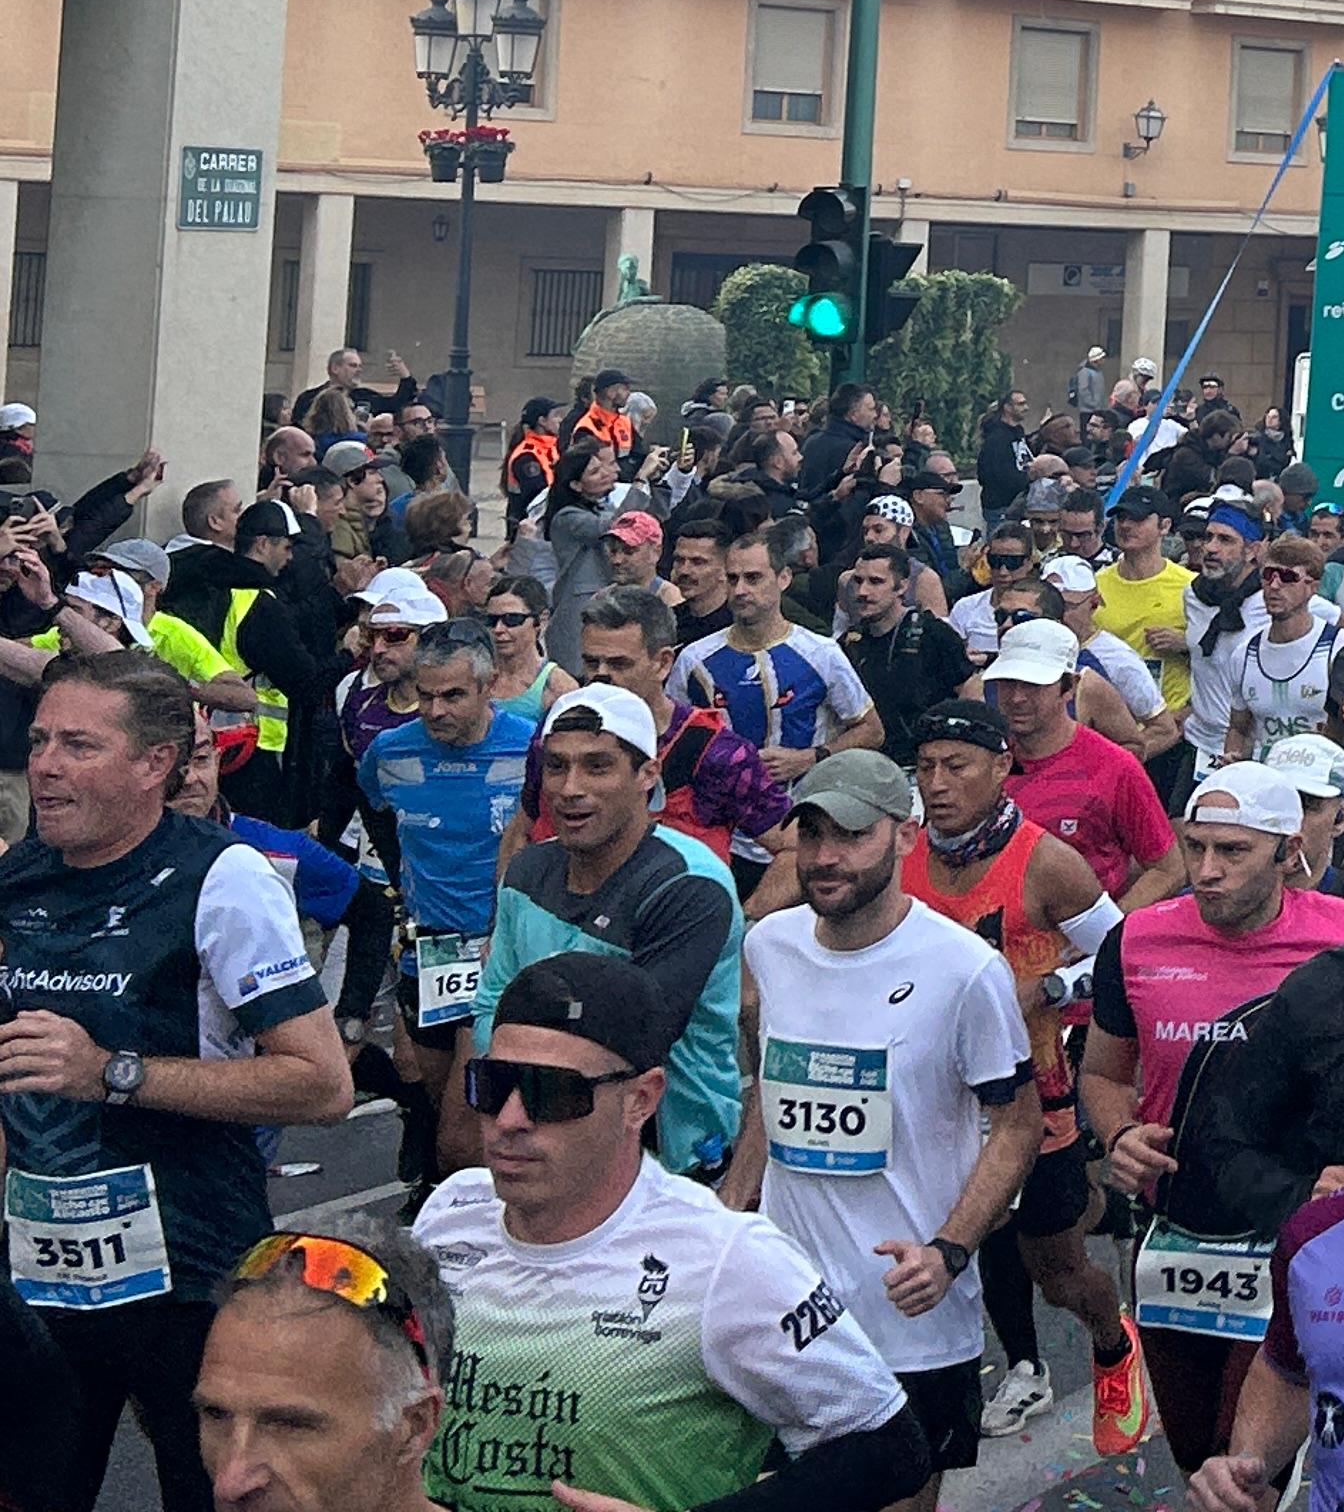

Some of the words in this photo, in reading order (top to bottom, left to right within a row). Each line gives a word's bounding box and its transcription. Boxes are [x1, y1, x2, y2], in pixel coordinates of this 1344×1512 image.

[200, 152, 257, 171] CARRER
[187, 199, 209, 223] DEL
[214, 200, 252, 224] PALAU
[1155, 1020, 1249, 1042] MAREA
[778, 1097, 866, 1136] 3130
[32, 1233, 126, 1270] 3511
[1160, 1266, 1259, 1301] 1943
[442, 1416, 577, 1485] Costa
